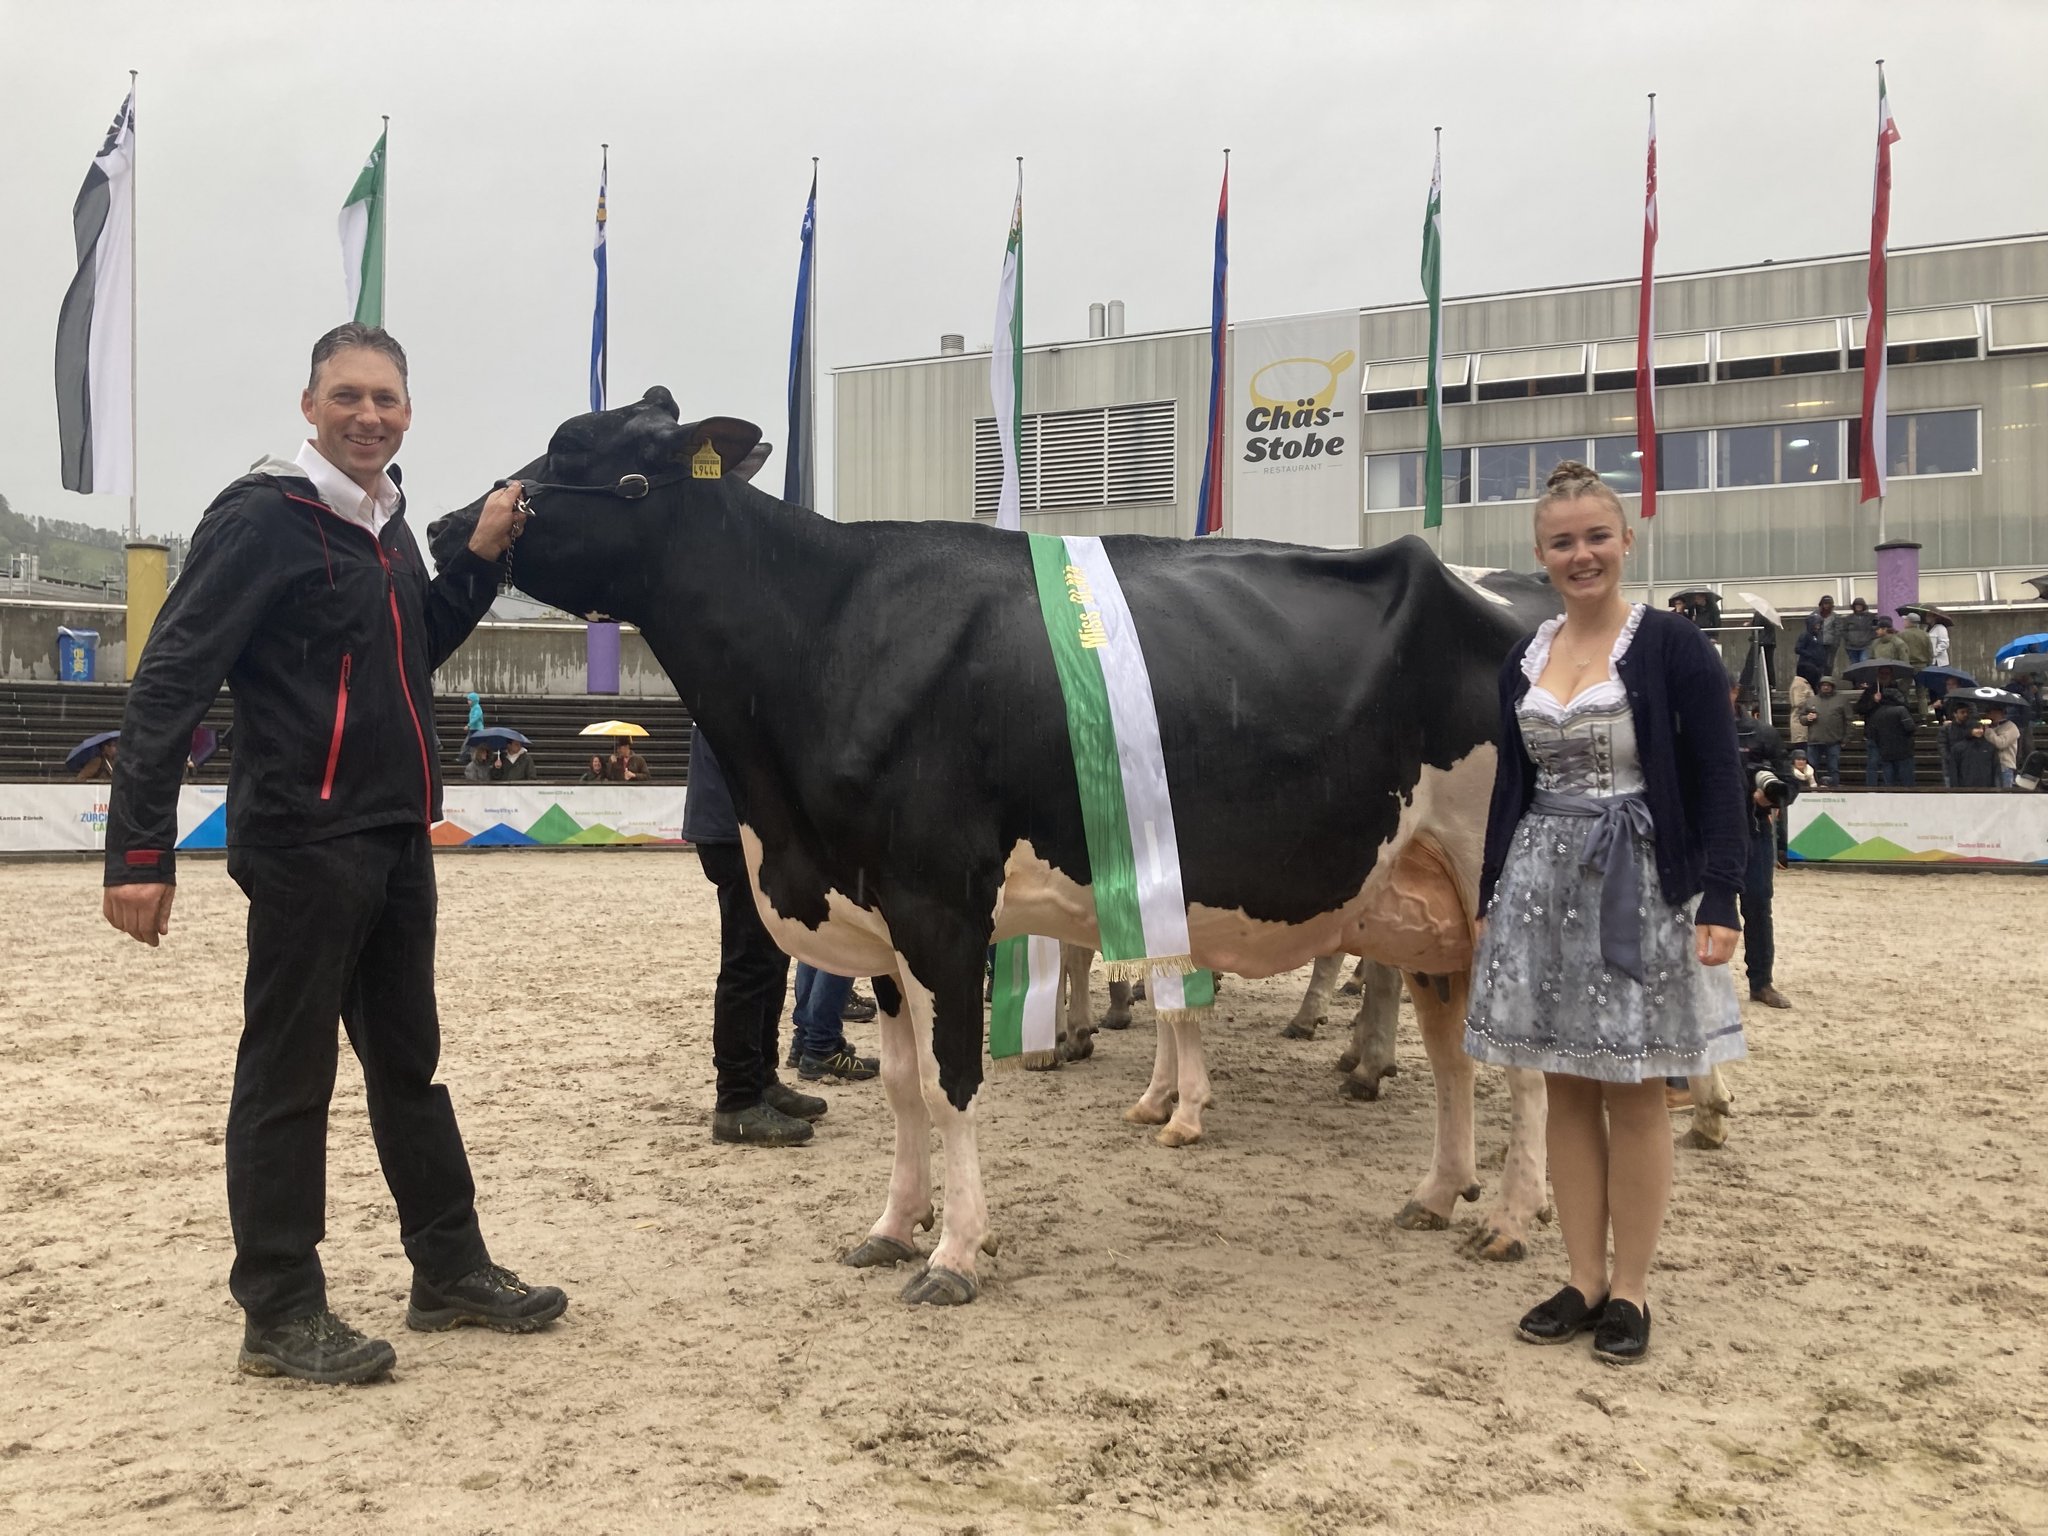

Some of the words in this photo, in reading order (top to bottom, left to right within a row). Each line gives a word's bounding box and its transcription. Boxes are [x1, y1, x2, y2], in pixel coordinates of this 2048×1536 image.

[1246, 398, 1344, 432] Chäs-
[1243, 432, 1345, 463] Stobe
[1263, 464, 1322, 474] RESTAURANT
[1078, 612, 1107, 649] Miss
